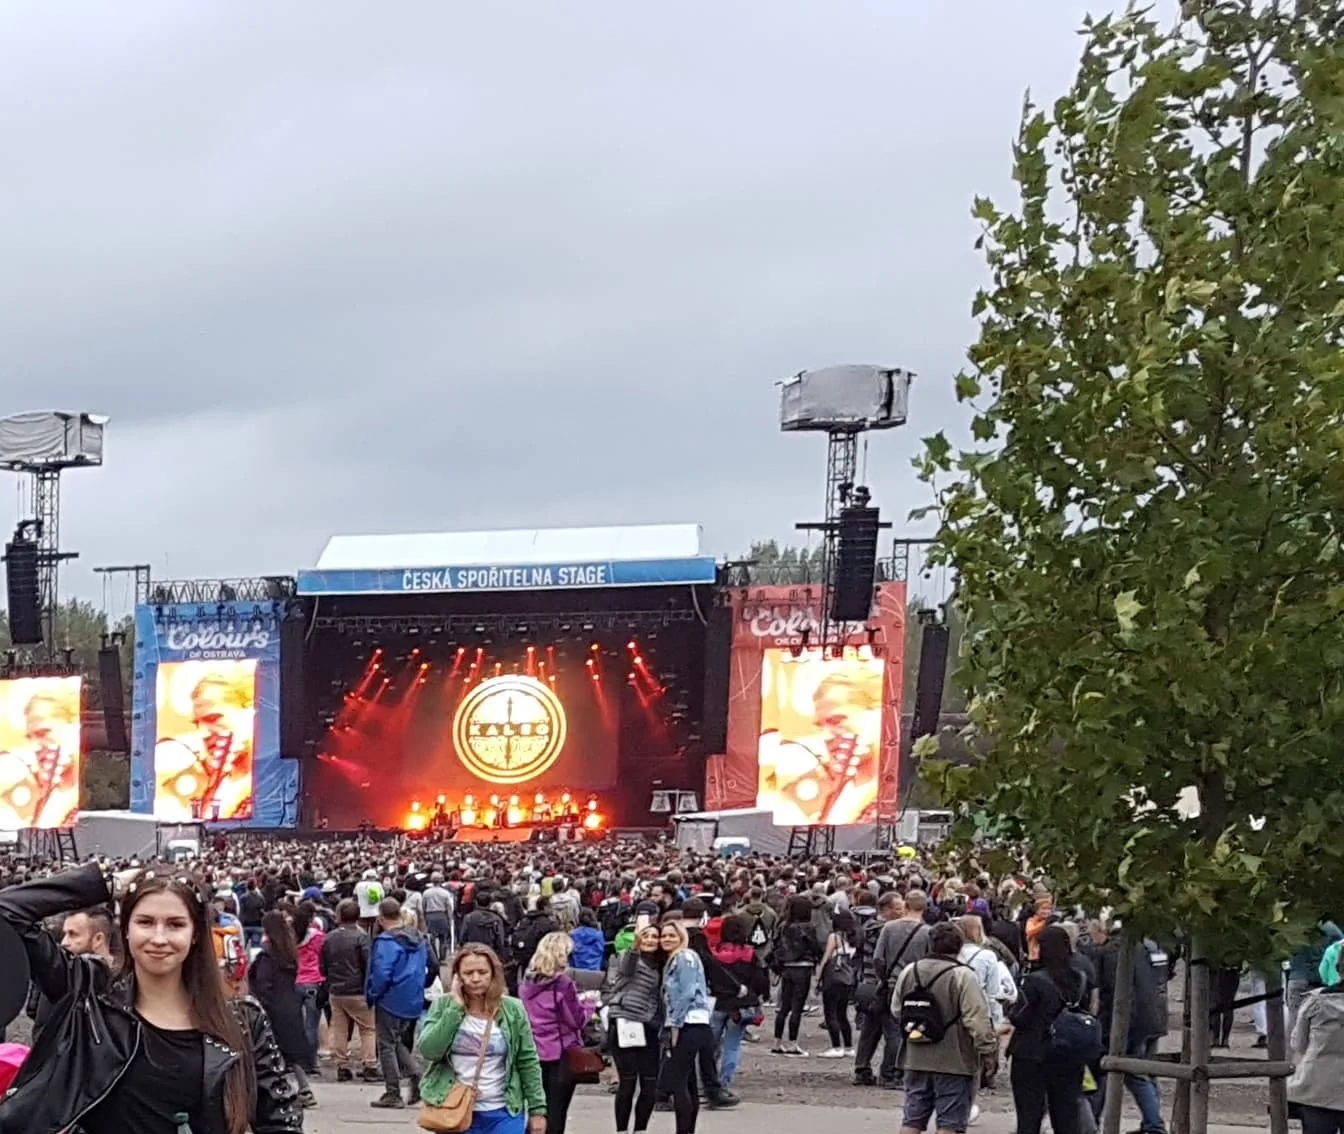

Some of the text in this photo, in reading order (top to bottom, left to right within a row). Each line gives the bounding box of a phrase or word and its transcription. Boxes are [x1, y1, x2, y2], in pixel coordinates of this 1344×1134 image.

[402, 565, 606, 590] ČESKÁ SPOŘITELNA STAGE
[750, 608, 865, 637] Colos
[167, 625, 270, 649] Colours
[202, 650, 247, 658] OSTRAVA
